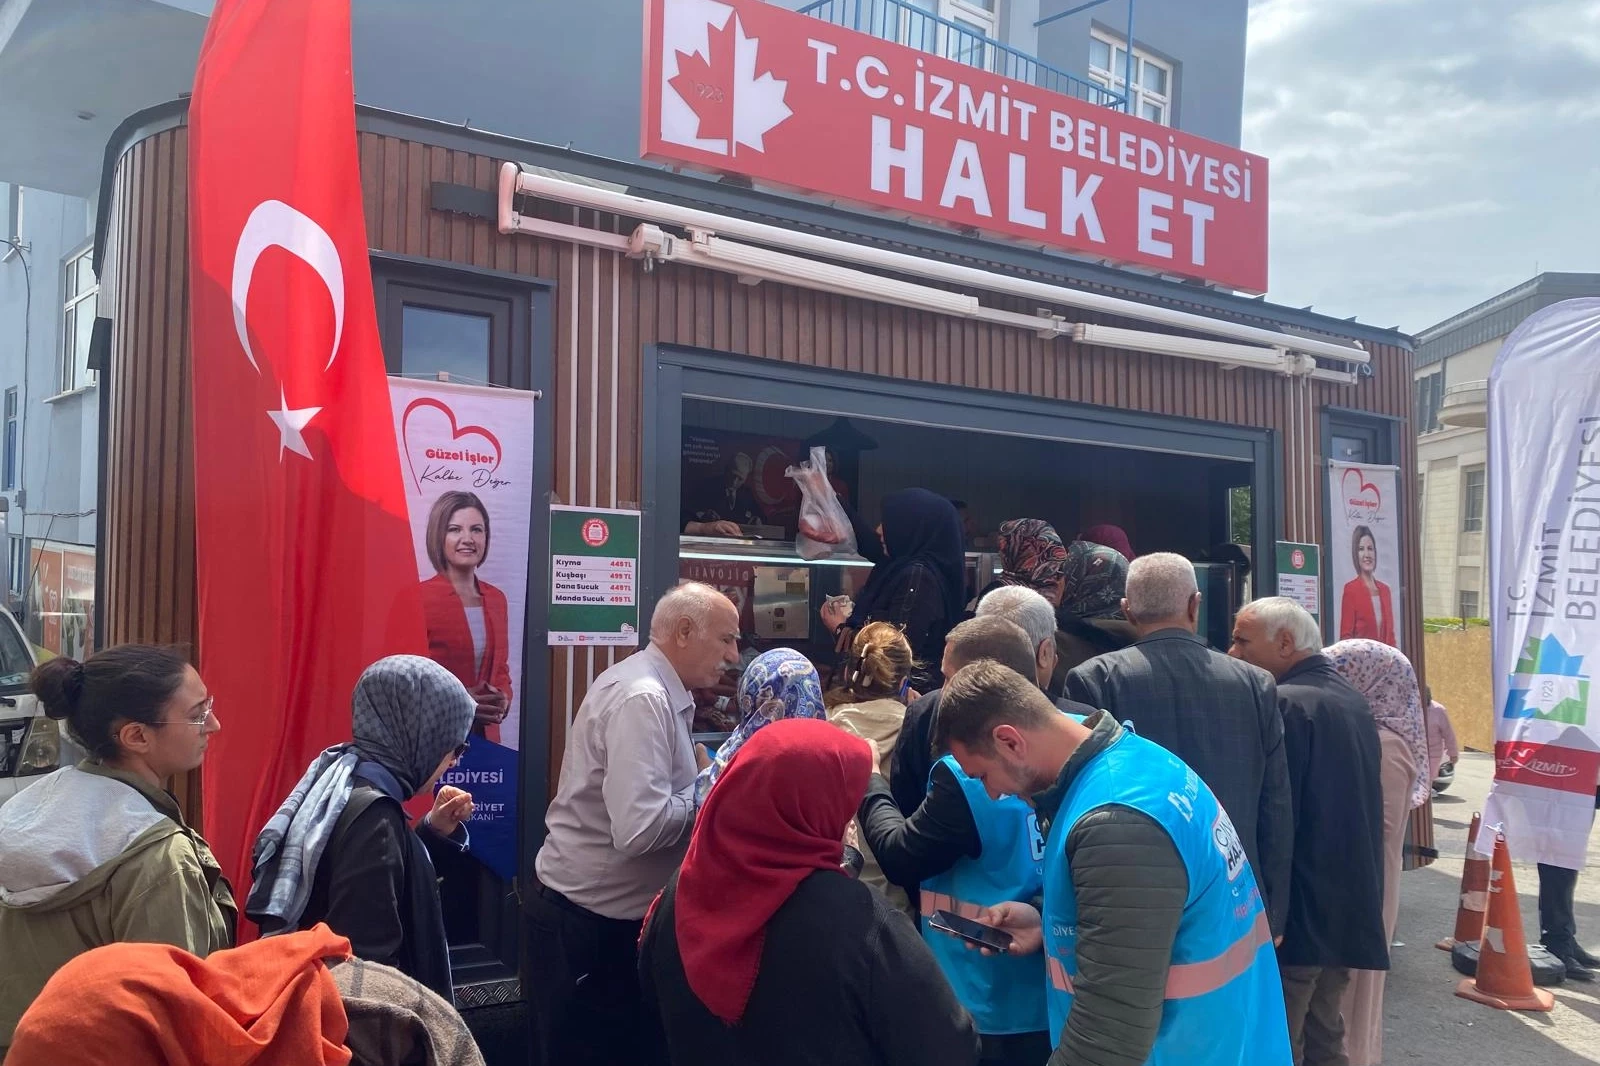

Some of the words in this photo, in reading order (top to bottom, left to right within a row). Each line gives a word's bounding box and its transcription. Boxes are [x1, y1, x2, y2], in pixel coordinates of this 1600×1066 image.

[914, 58, 1037, 141] İZMİT
[1050, 109, 1251, 203] BELEDİYESİ
[870, 114, 1106, 244] HALK
[1137, 186, 1215, 266] ET
[425, 448, 463, 460] Güzel
[420, 464, 463, 483] Kalbe
[556, 559, 582, 568] Kıyma
[556, 571, 586, 580] Kuşbaşı
[1507, 579, 1527, 621] T.C.
[1541, 680, 1554, 702] 1923
[435, 768, 504, 785] LEDİYESİ
[473, 801, 505, 812] RİYET
